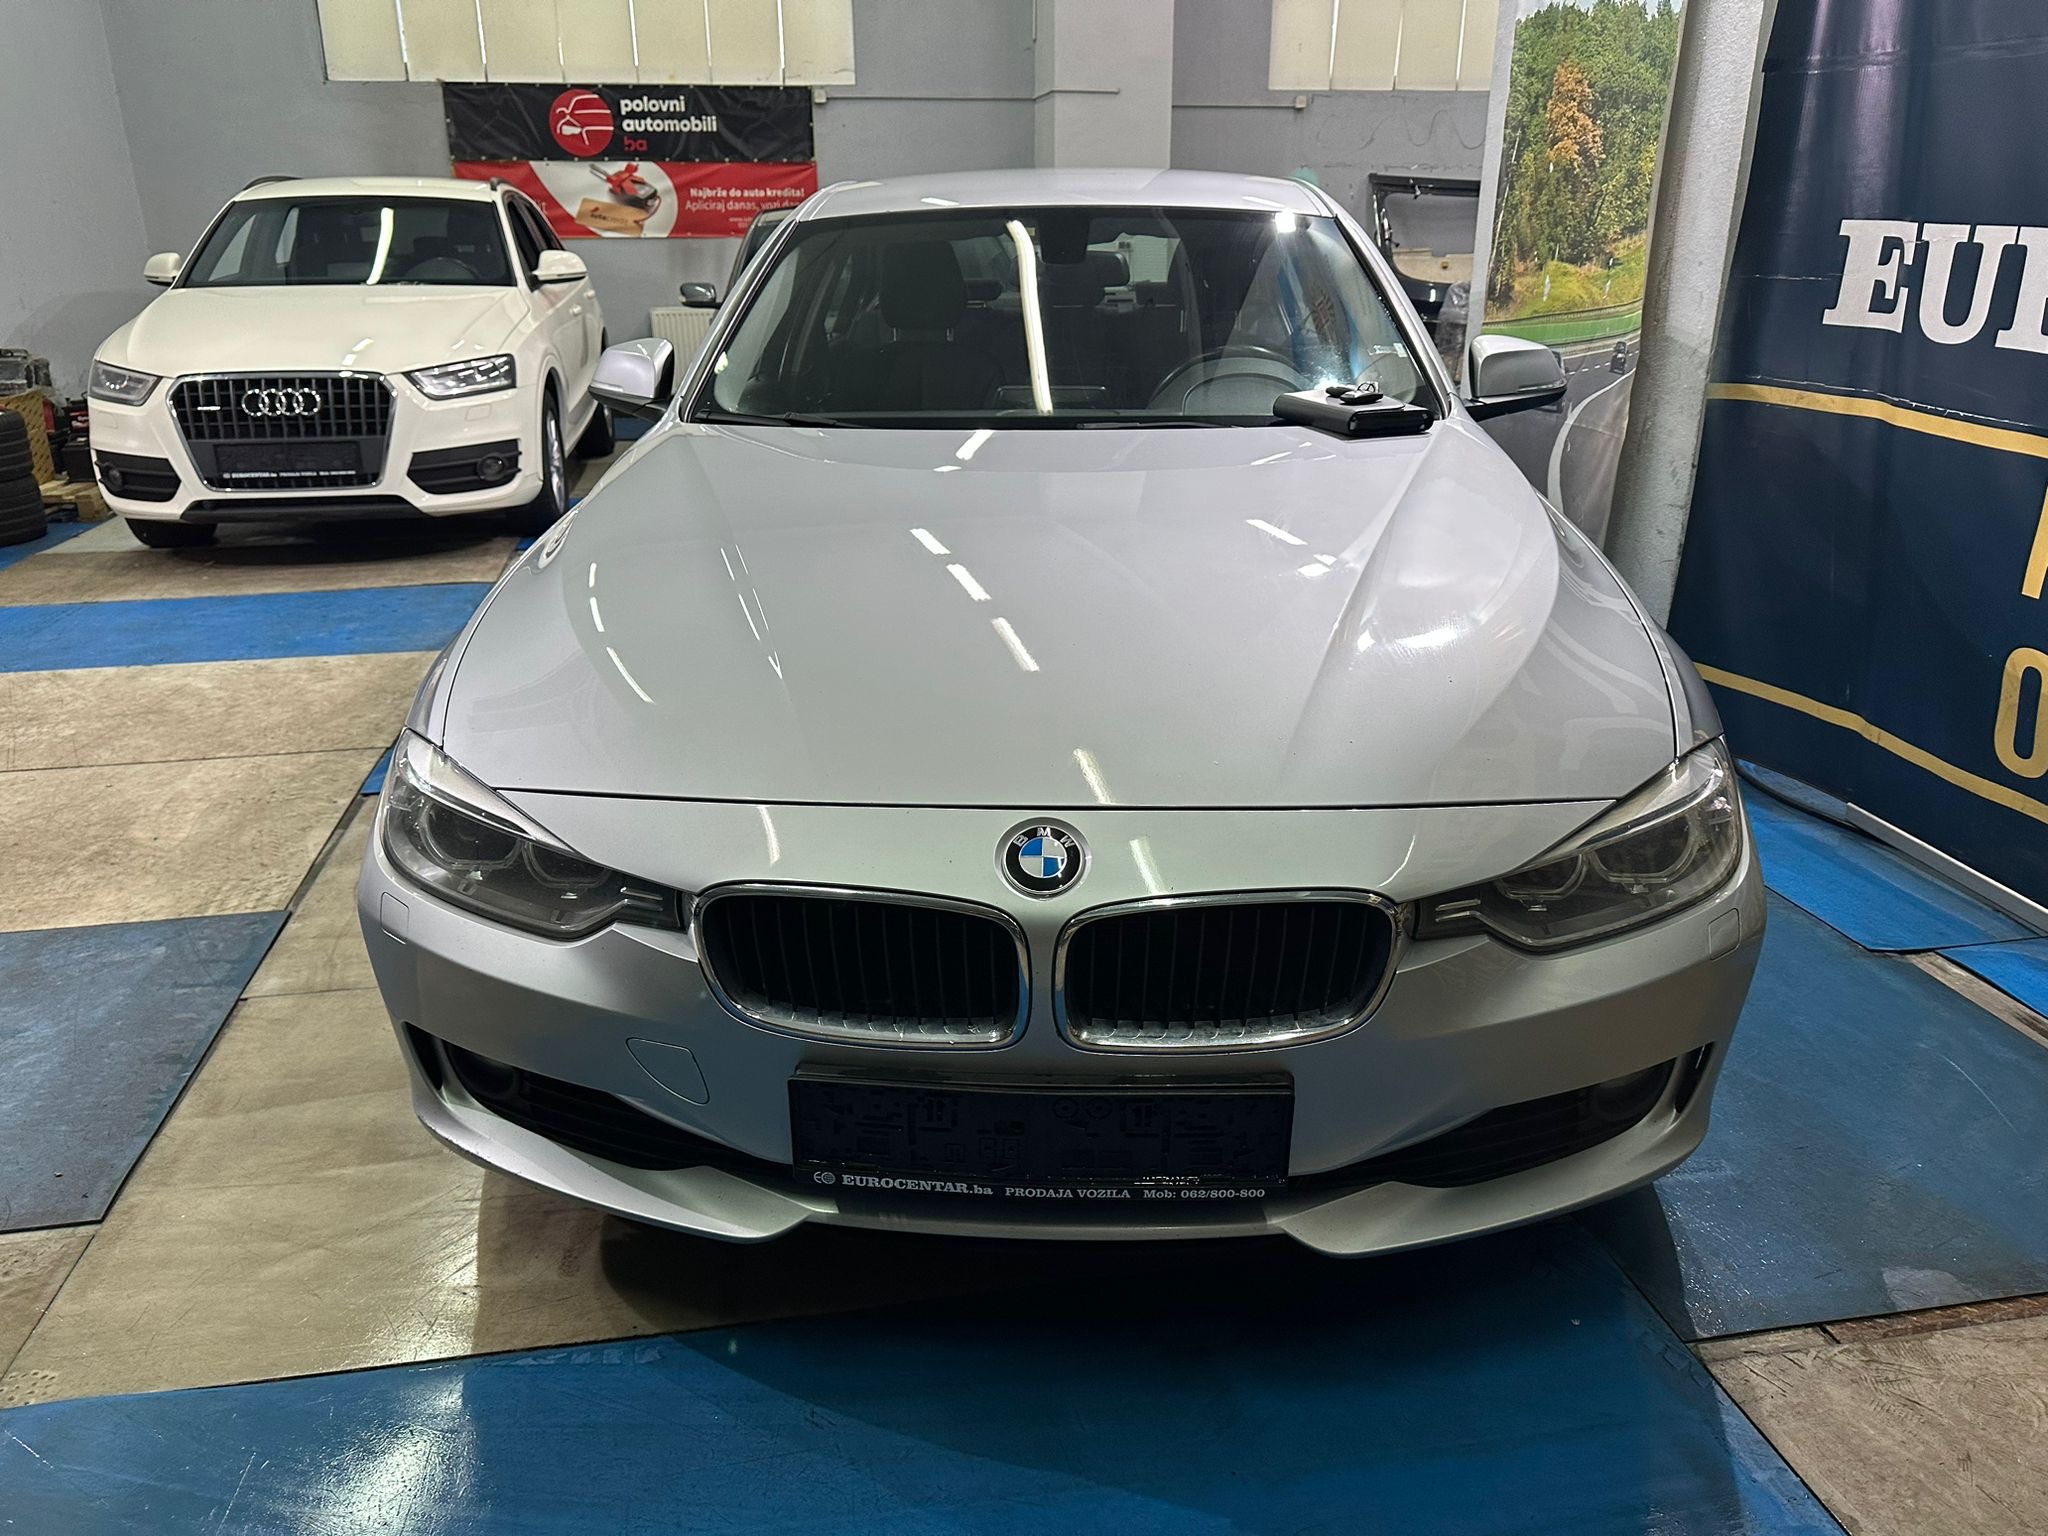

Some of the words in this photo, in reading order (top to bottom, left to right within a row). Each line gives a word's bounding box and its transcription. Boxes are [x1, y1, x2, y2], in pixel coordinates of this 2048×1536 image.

[620, 95, 686, 115] polovni
[622, 115, 718, 132] automobili
[690, 187, 727, 199] Najbrže
[729, 187, 742, 198] do
[743, 188, 766, 198] auto
[767, 187, 805, 198] kredita!
[685, 200, 725, 212] Apliciraj
[1013, 826, 1075, 848] BMW
[842, 1174, 994, 1195] EUROCENTAR.ba
[1005, 1187, 1073, 1199] PRODAJA
[1077, 1188, 1131, 1199] VOZILA
[1143, 1188, 1177, 1199] Mob:
[1180, 1187, 1266, 1199] 062/800-800
